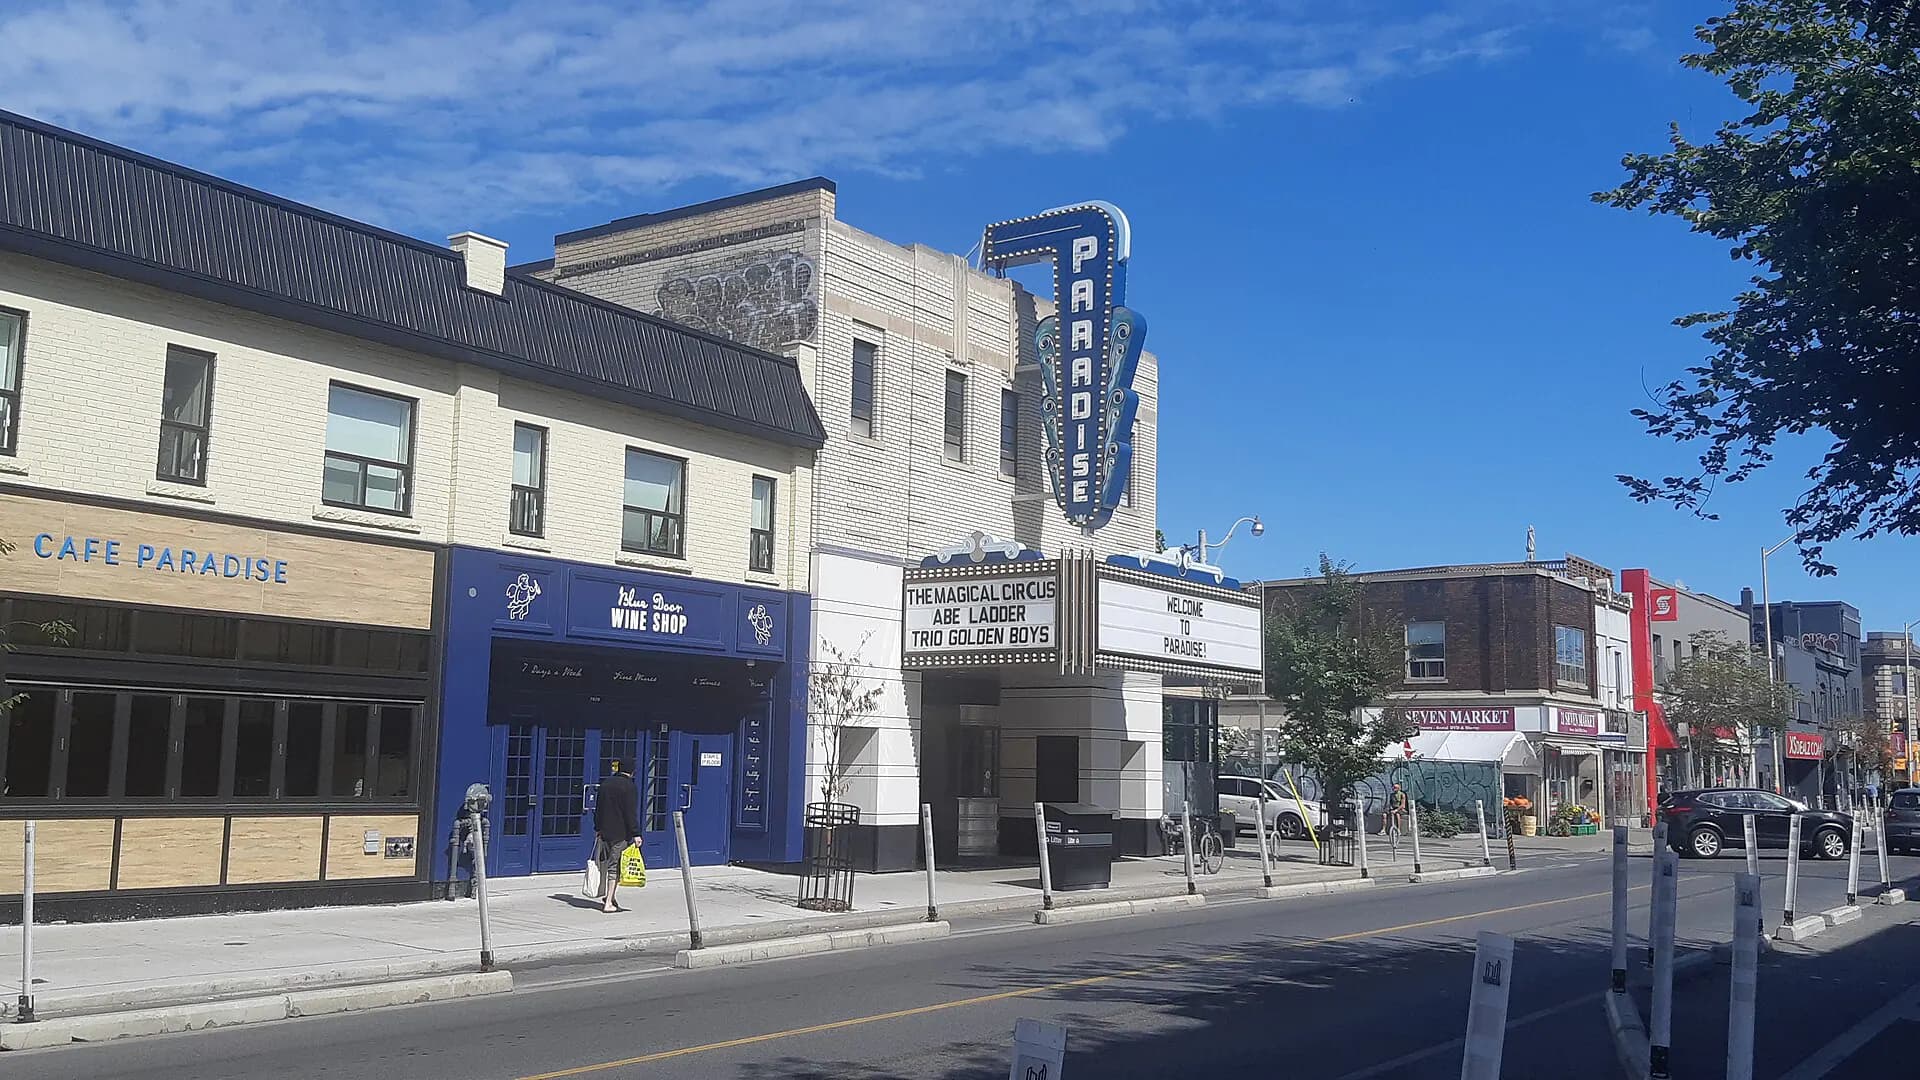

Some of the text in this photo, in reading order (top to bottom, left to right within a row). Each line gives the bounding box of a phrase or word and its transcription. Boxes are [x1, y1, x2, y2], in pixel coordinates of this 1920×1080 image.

[1071, 236, 1098, 503] PARADISE
[33, 532, 288, 584] CAFE PARADISE
[618, 586, 683, 613] Blue Door
[907, 581, 1056, 605] THE MAGICAL CIRCUS
[933, 604, 1026, 626] ABE LADDER
[1166, 595, 1204, 618] WELCOME
[611, 607, 688, 635] WINE SHOP
[1179, 619, 1190, 636] TO
[912, 626, 1049, 647] TRIO GOLDEN BOYS
[1163, 637, 1207, 658] PARADISE!
[1449, 709, 1510, 724] MARKET
